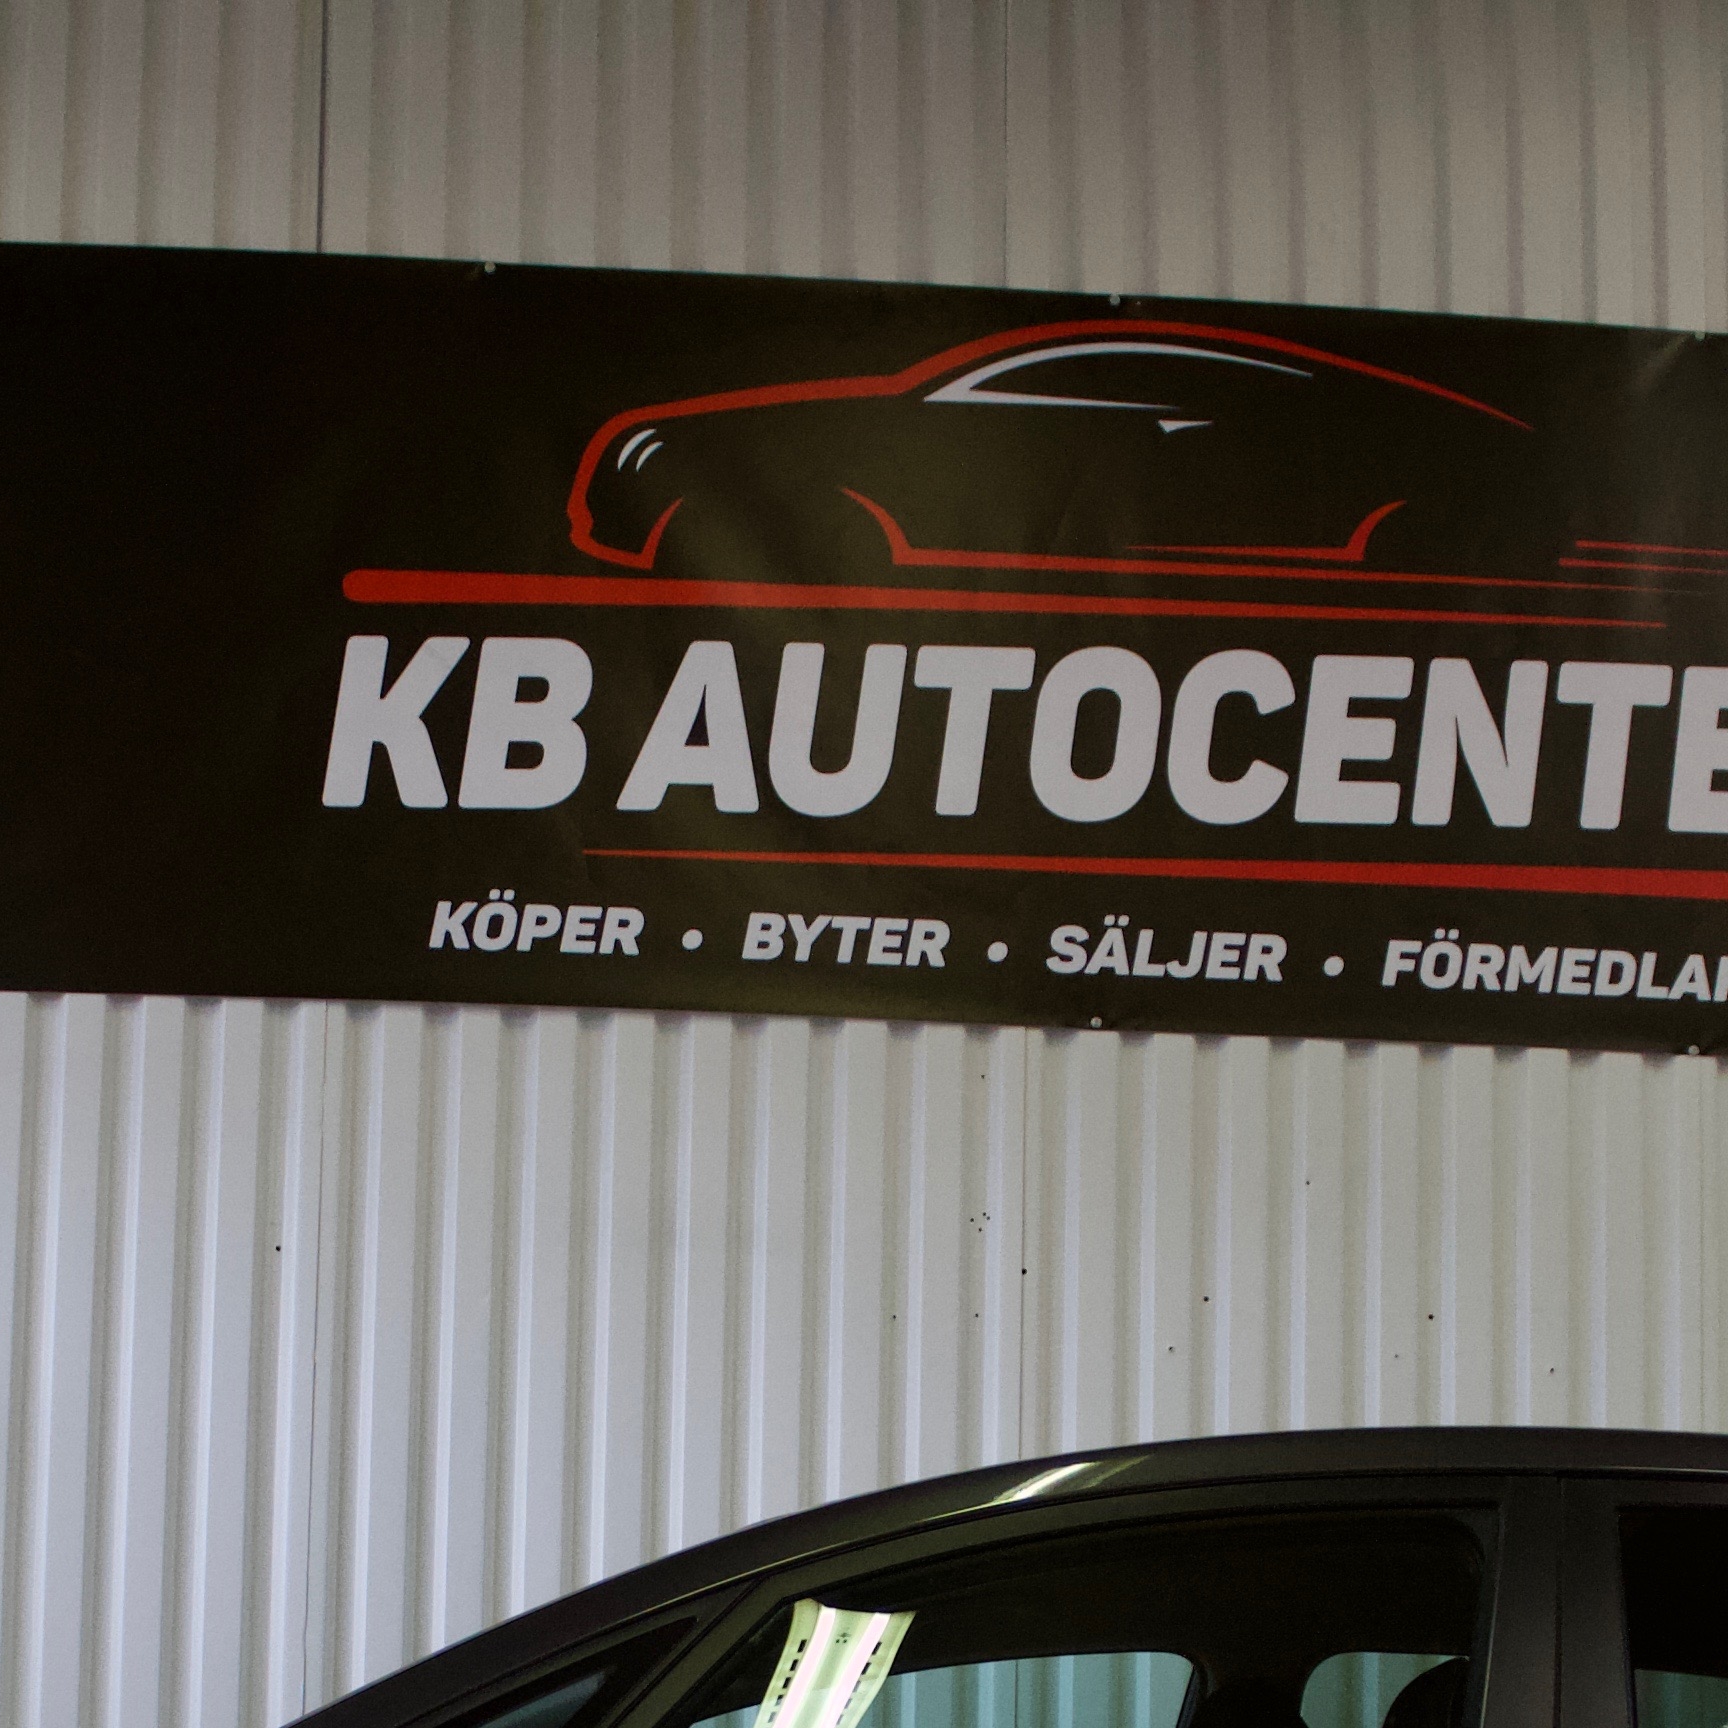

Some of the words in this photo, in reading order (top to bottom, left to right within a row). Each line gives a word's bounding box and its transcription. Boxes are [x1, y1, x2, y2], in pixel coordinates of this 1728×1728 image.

[321, 635, 593, 810] KB
[428, 888, 645, 956] KÖPER
[741, 912, 951, 968] BYTER
[1045, 914, 1288, 982] SÄLJER
